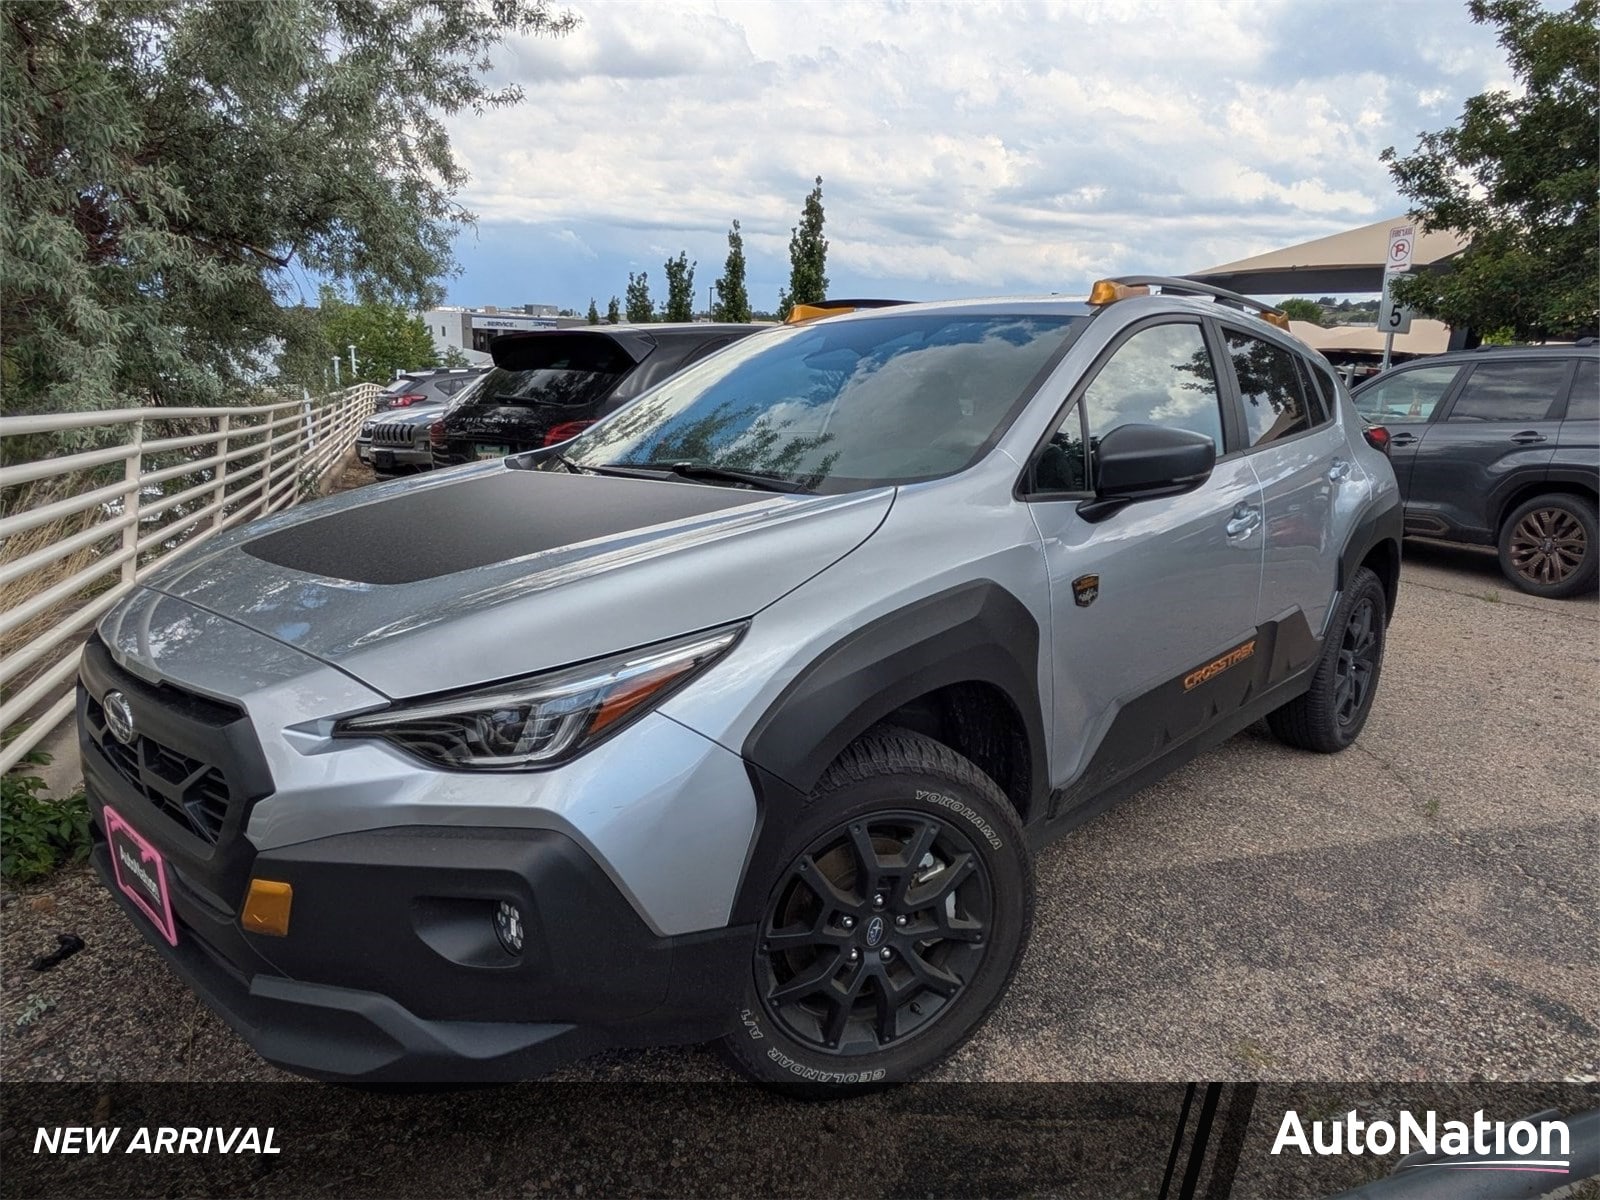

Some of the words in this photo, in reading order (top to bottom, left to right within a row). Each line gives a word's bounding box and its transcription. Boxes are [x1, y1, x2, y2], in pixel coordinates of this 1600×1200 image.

[1389, 304, 1402, 327] 5
[1184, 641, 1256, 690] CROSSTREK
[915, 789, 1003, 850] YOKOHAMA
[767, 1047, 886, 1083] GEOLANDAR
